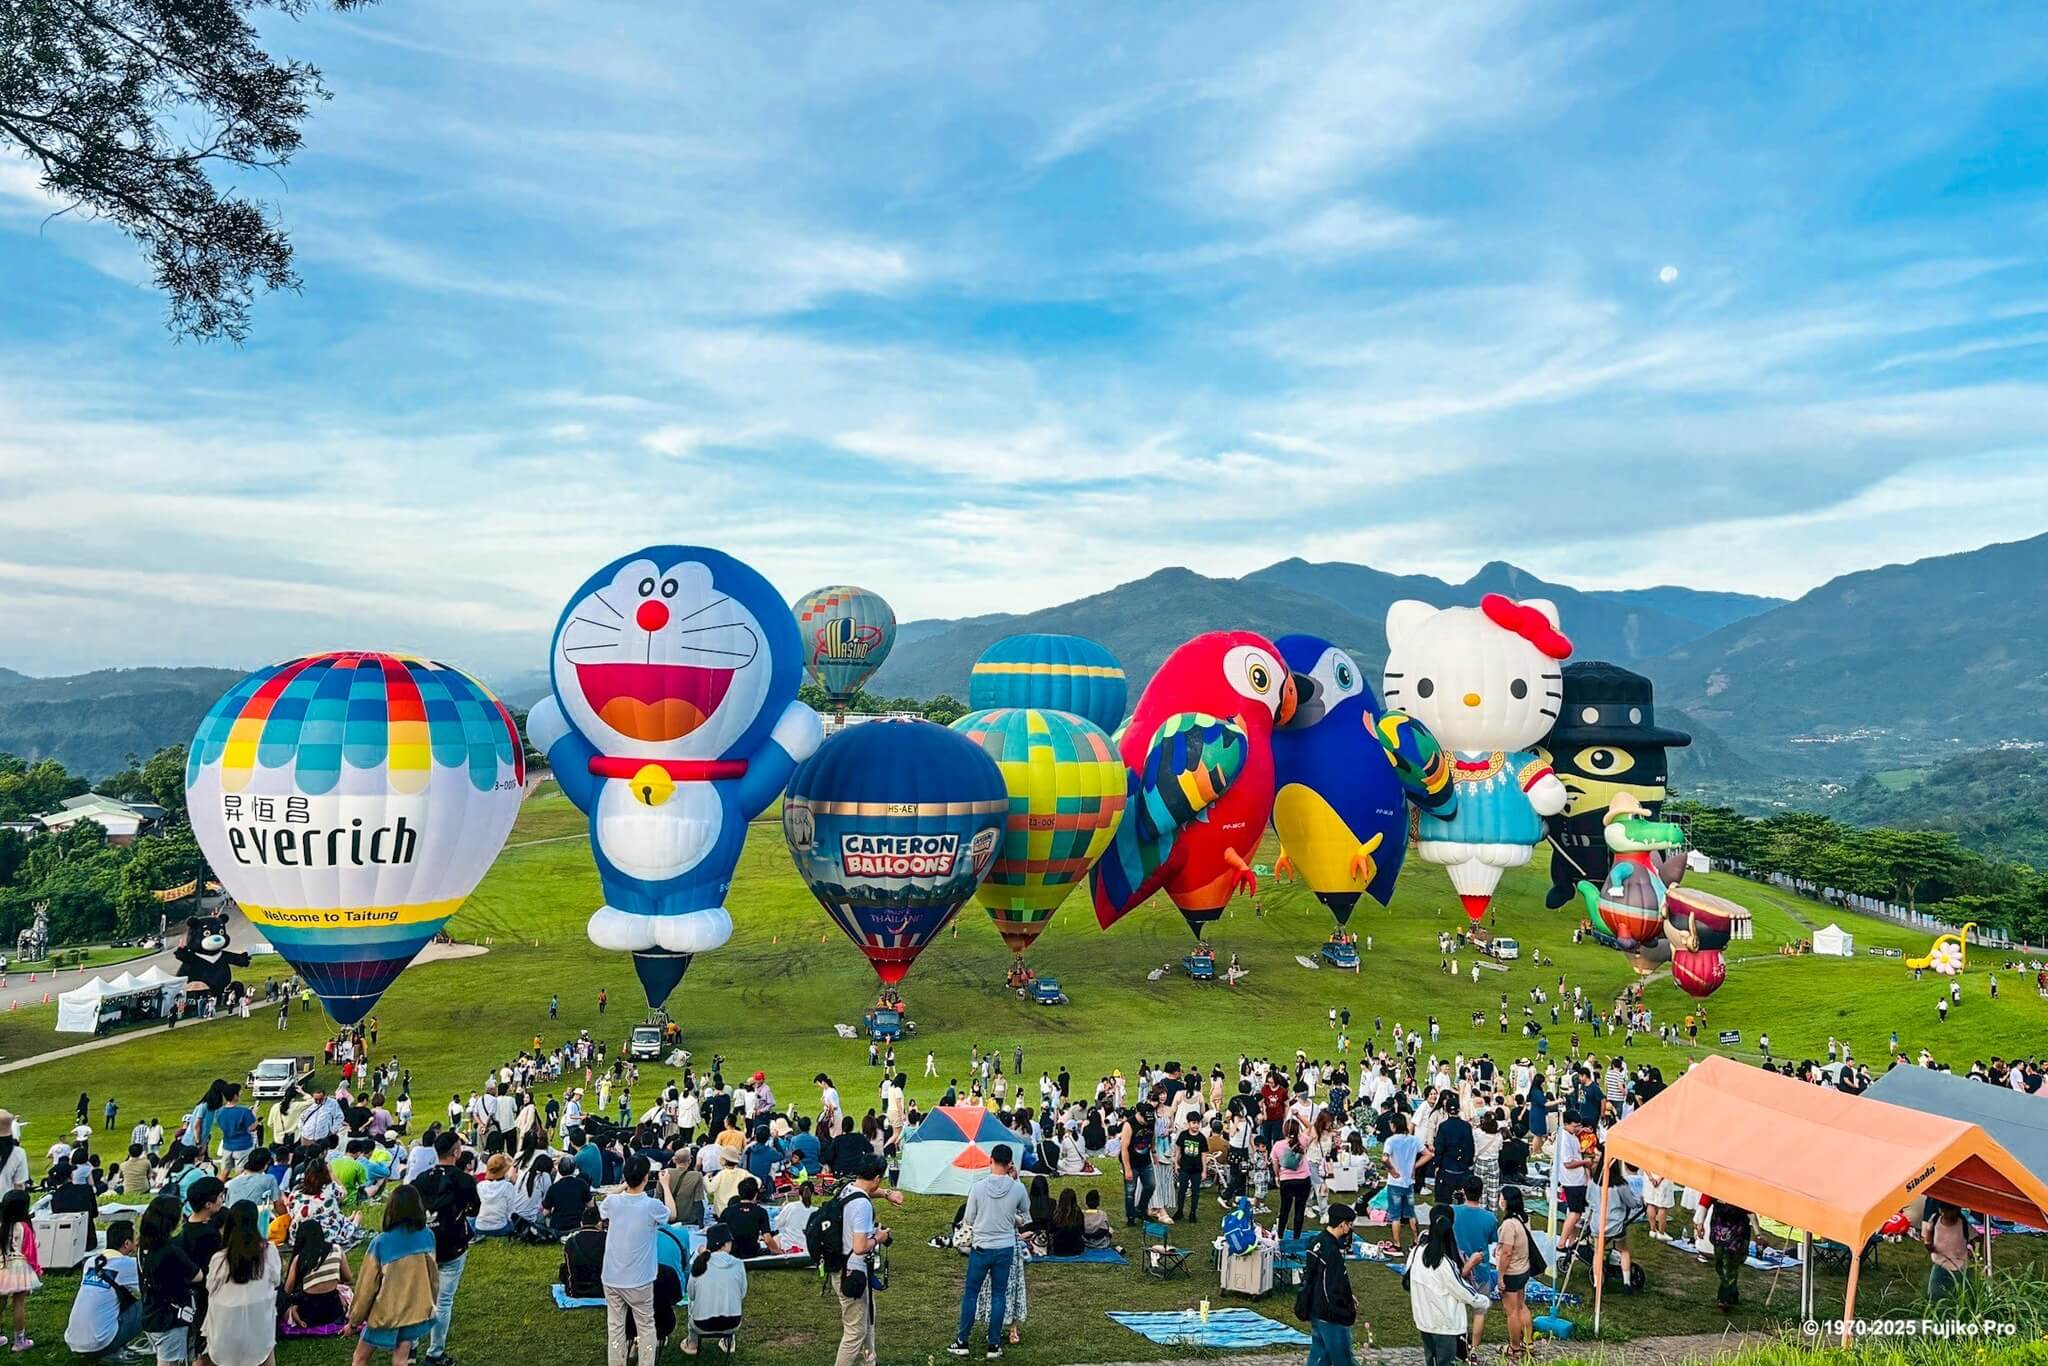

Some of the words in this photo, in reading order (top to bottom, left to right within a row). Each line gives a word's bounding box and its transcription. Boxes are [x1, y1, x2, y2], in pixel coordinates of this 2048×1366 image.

[888, 805, 918, 813] HS-AEY
[228, 817, 417, 866] everrich
[845, 836, 956, 855] CAMERON
[846, 856, 952, 874] BALLOONS
[262, 910, 320, 922] Welcome
[324, 912, 340, 922] to
[344, 911, 399, 921] Taitung
